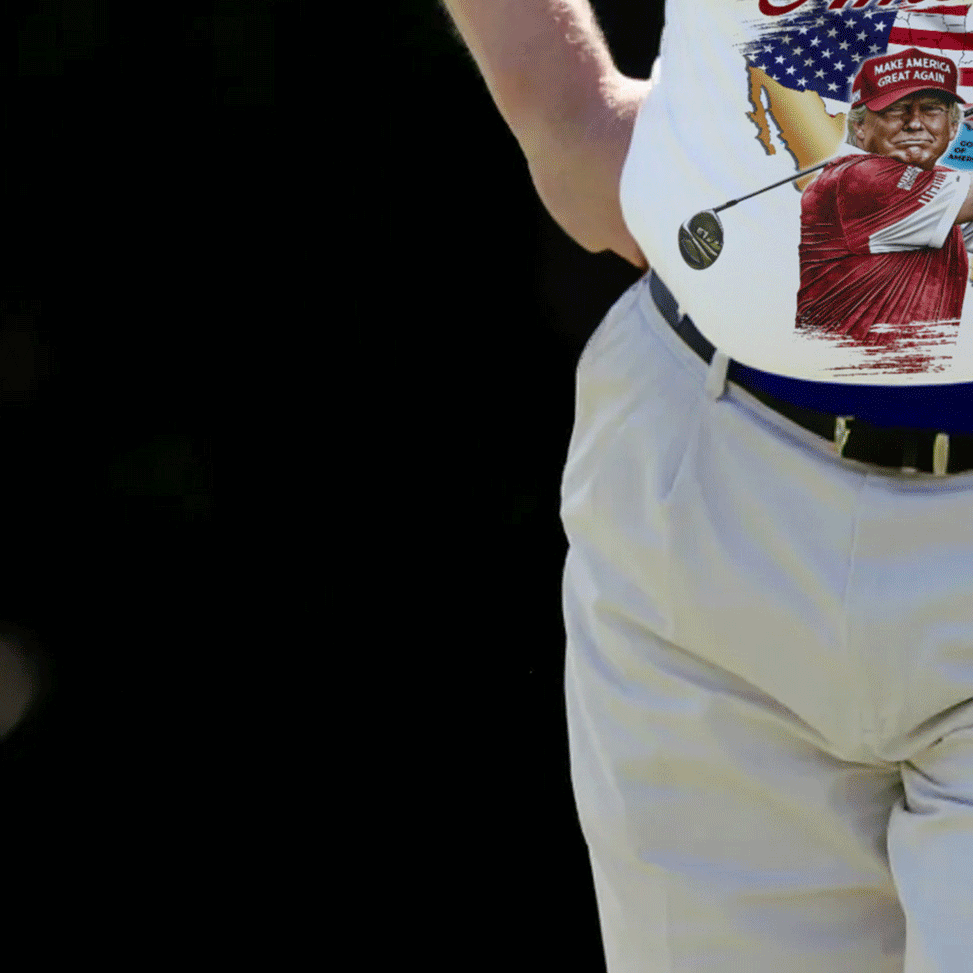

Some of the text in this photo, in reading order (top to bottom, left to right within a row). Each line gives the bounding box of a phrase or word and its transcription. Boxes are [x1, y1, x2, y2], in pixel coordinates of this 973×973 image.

[874, 58, 951, 75] MAKE AMERICA
[877, 70, 945, 87] GREAT AGAIN
